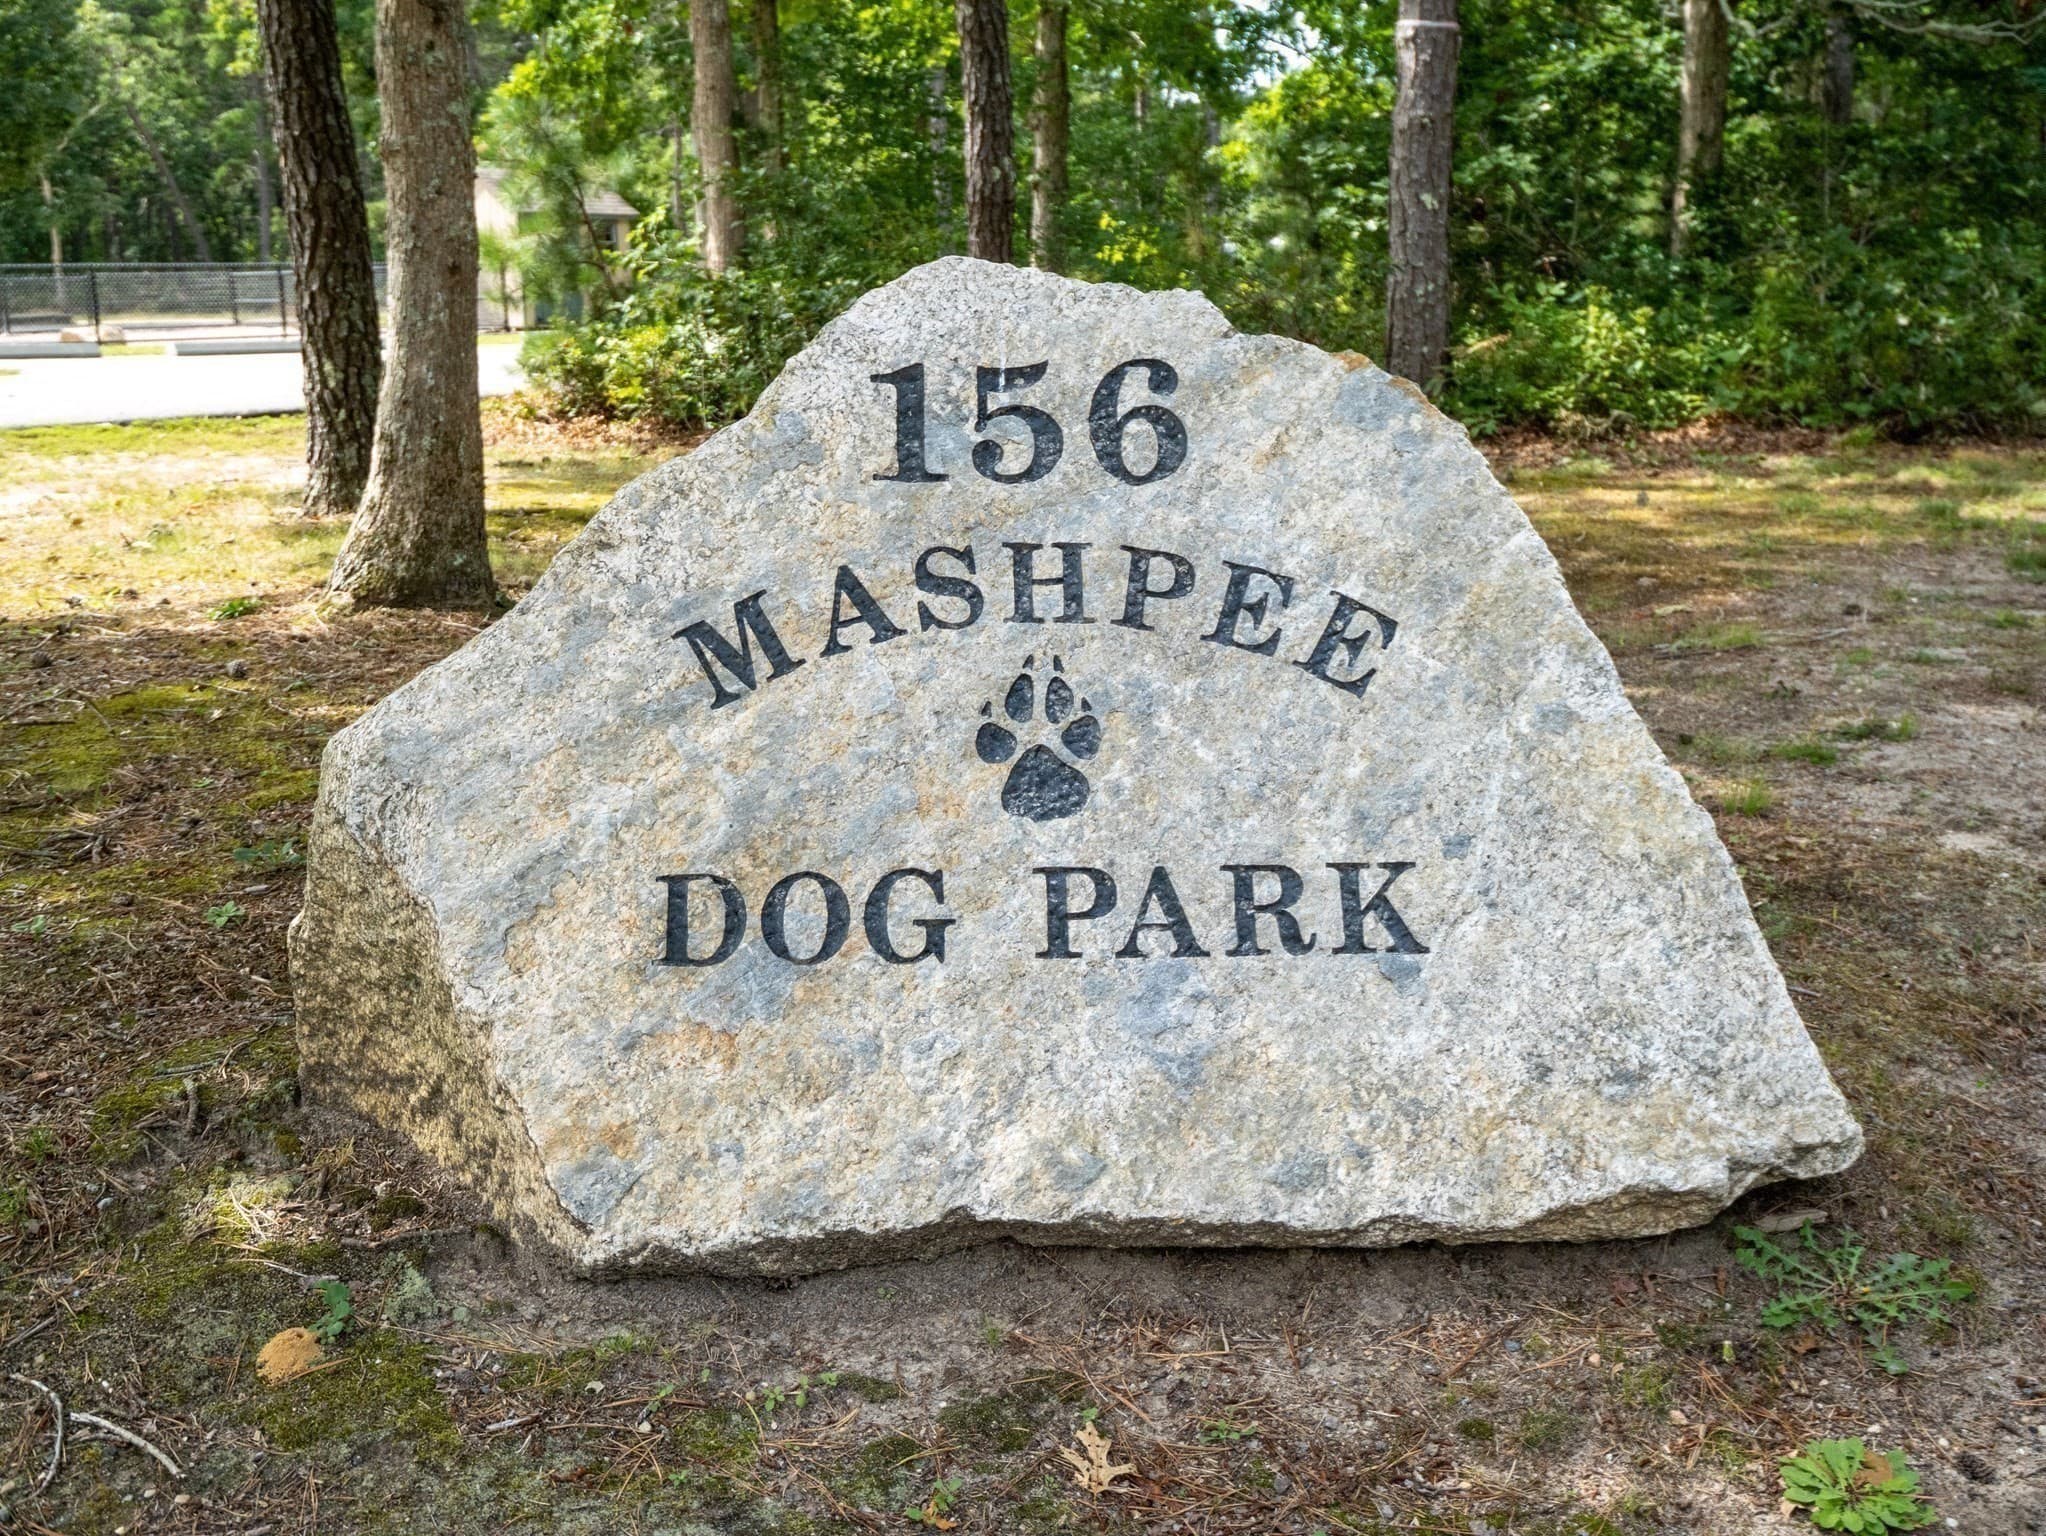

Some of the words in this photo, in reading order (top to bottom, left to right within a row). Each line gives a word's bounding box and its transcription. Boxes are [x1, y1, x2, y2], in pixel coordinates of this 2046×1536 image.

[871, 358, 1187, 486] 156
[672, 541, 1399, 709] MASHPEE
[654, 867, 957, 967] DOG
[1033, 861, 1431, 959] PARK
